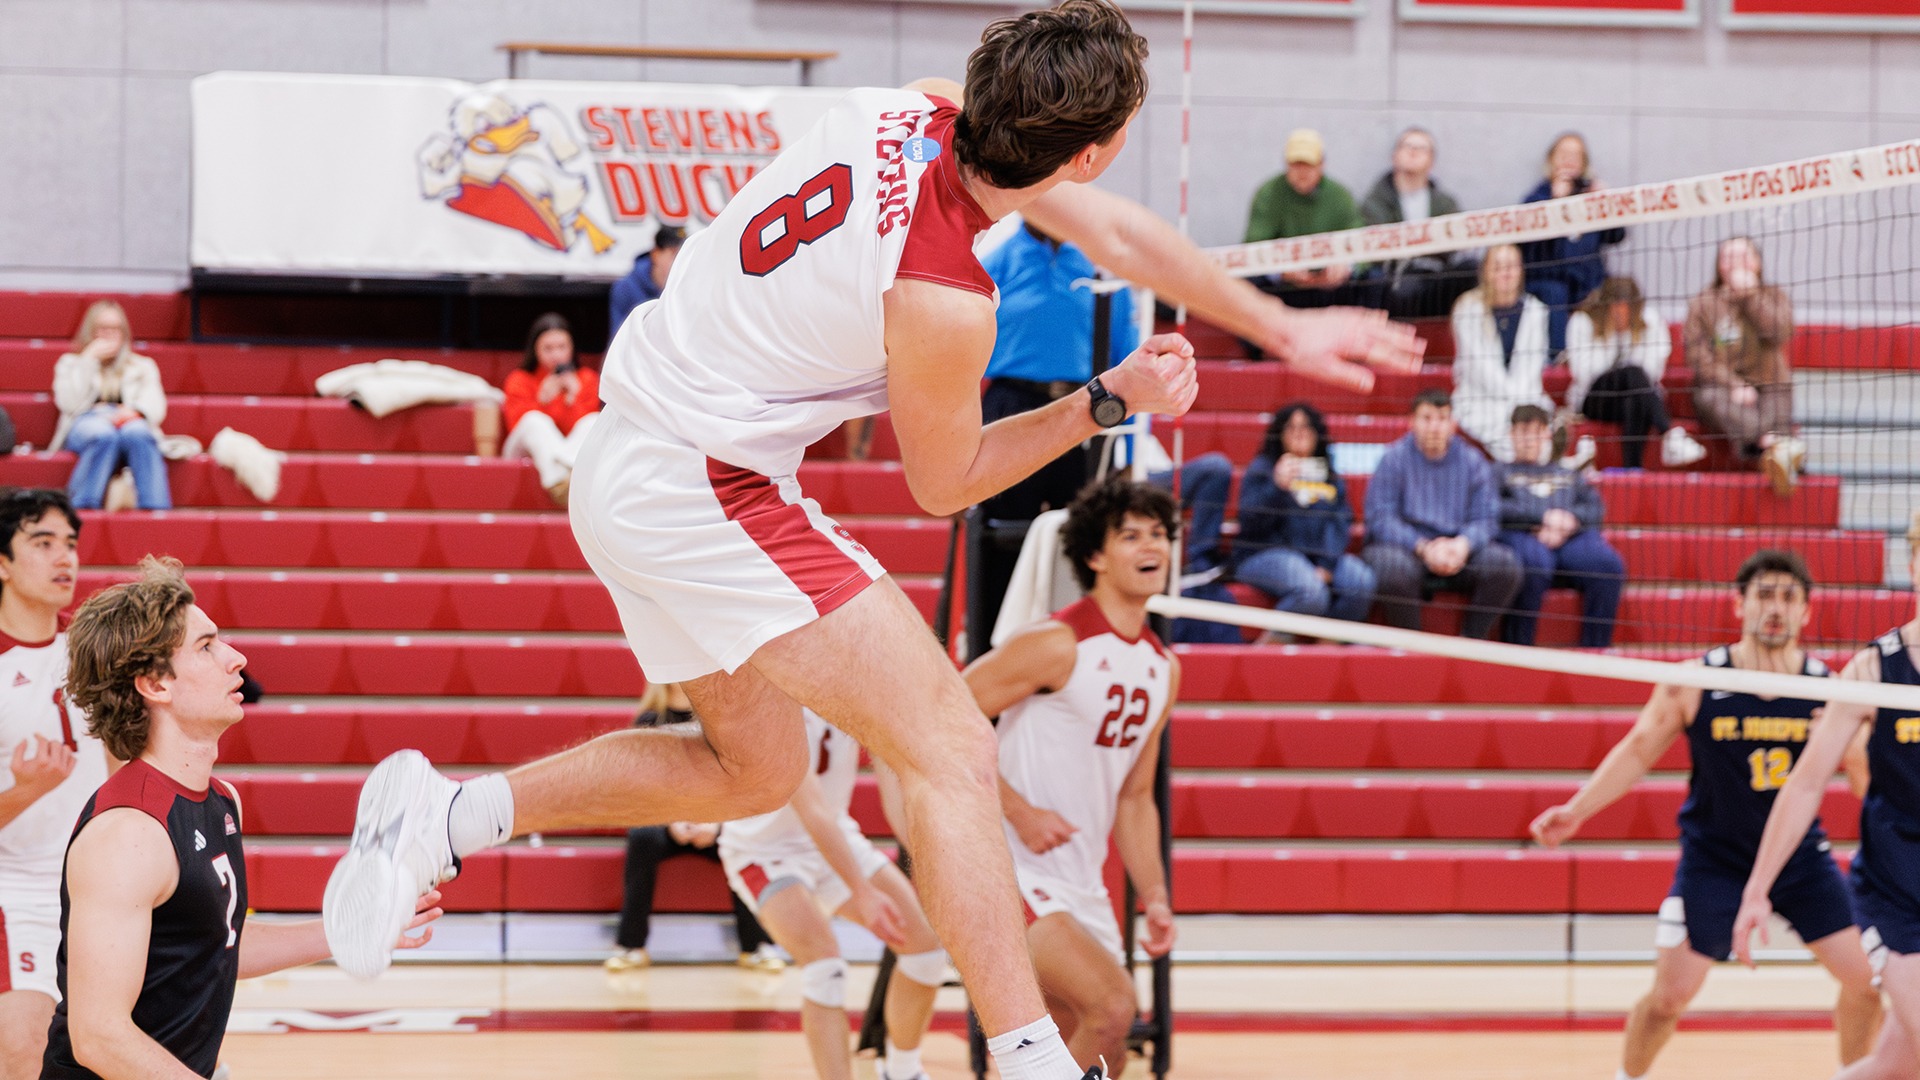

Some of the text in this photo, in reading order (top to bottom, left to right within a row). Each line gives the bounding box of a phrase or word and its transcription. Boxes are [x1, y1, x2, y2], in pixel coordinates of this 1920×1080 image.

[582, 105, 782, 155] STEVENS
[739, 162, 854, 277] 8
[1095, 684, 1151, 748] 22
[1747, 746, 1793, 792] 12
[211, 852, 237, 949] 7
[19, 951, 35, 973] S
